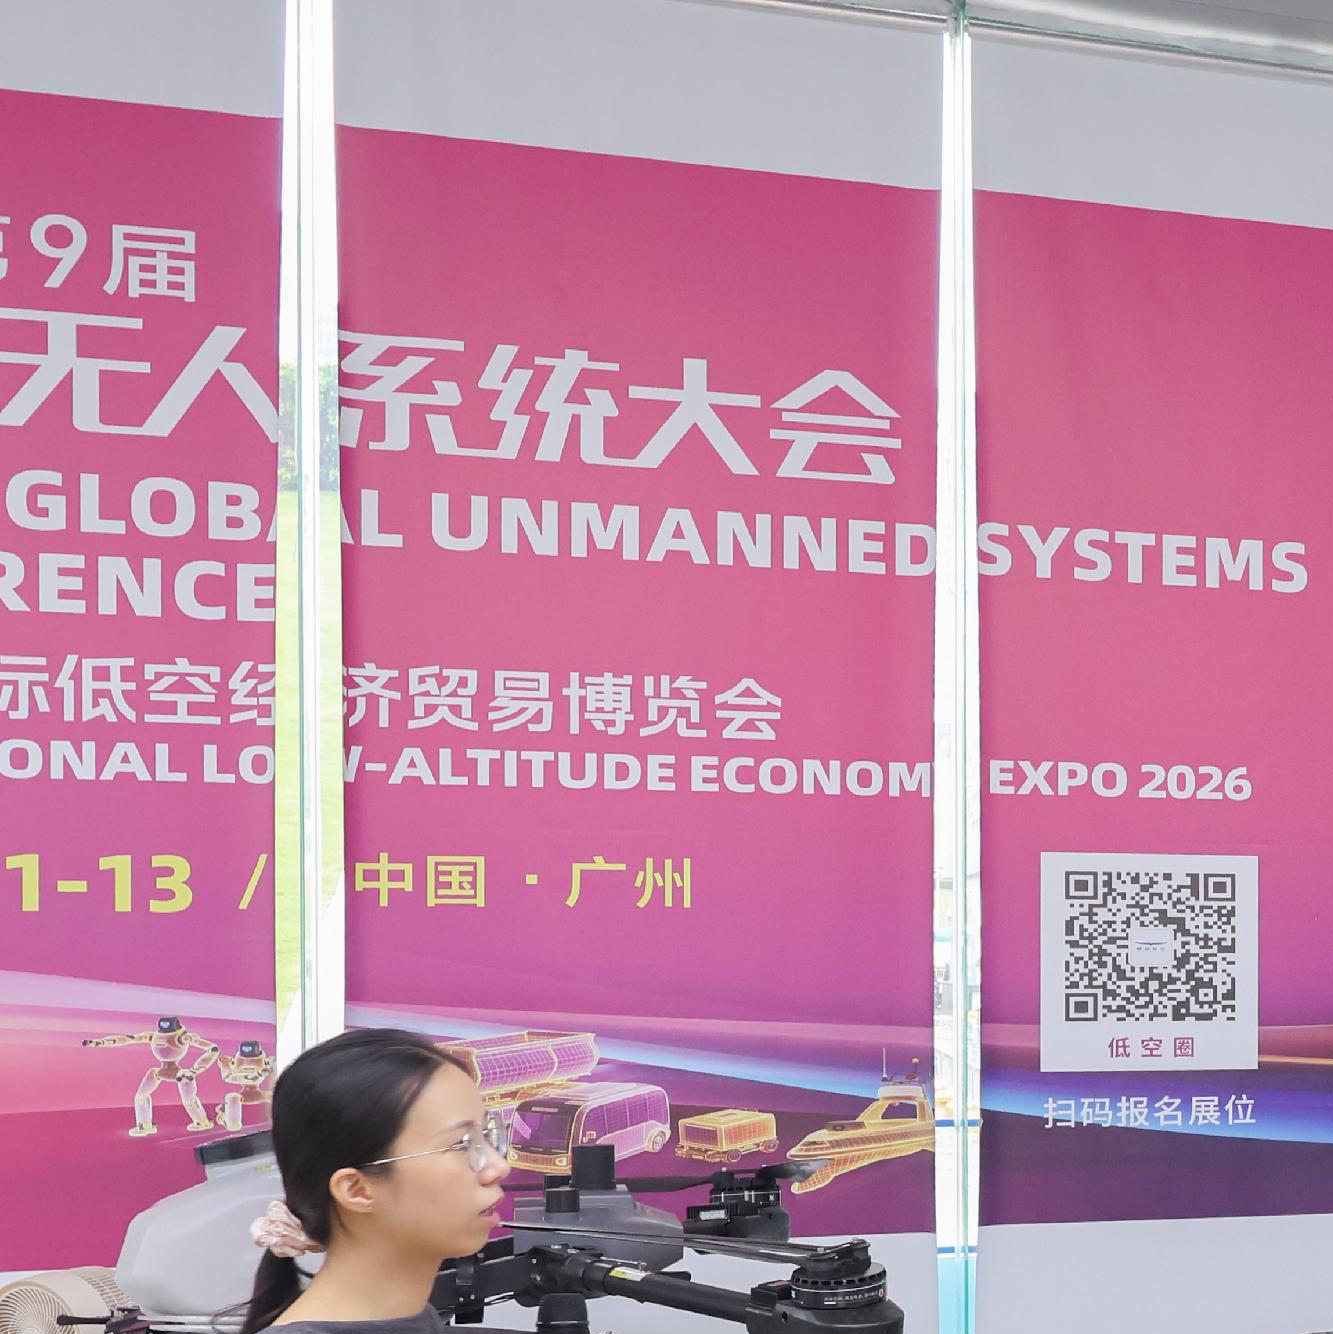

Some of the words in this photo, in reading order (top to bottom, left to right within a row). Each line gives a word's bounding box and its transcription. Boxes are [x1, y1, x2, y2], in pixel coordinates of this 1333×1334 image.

[0, 213, 197, 302] 9届
[6, 469, 404, 549] GLOBL
[430, 491, 937, 577] UNMANNED
[976, 521, 1309, 595] SYSTEMS
[203, 741, 677, 793] LO-ALTITUDE
[689, 755, 936, 799] ECONOM
[988, 758, 1128, 799] EXPO
[1138, 763, 1253, 802] 2026
[1107, 1036, 1195, 1059] 低空圈
[1042, 1093, 1257, 1130] 扫码报名展位
